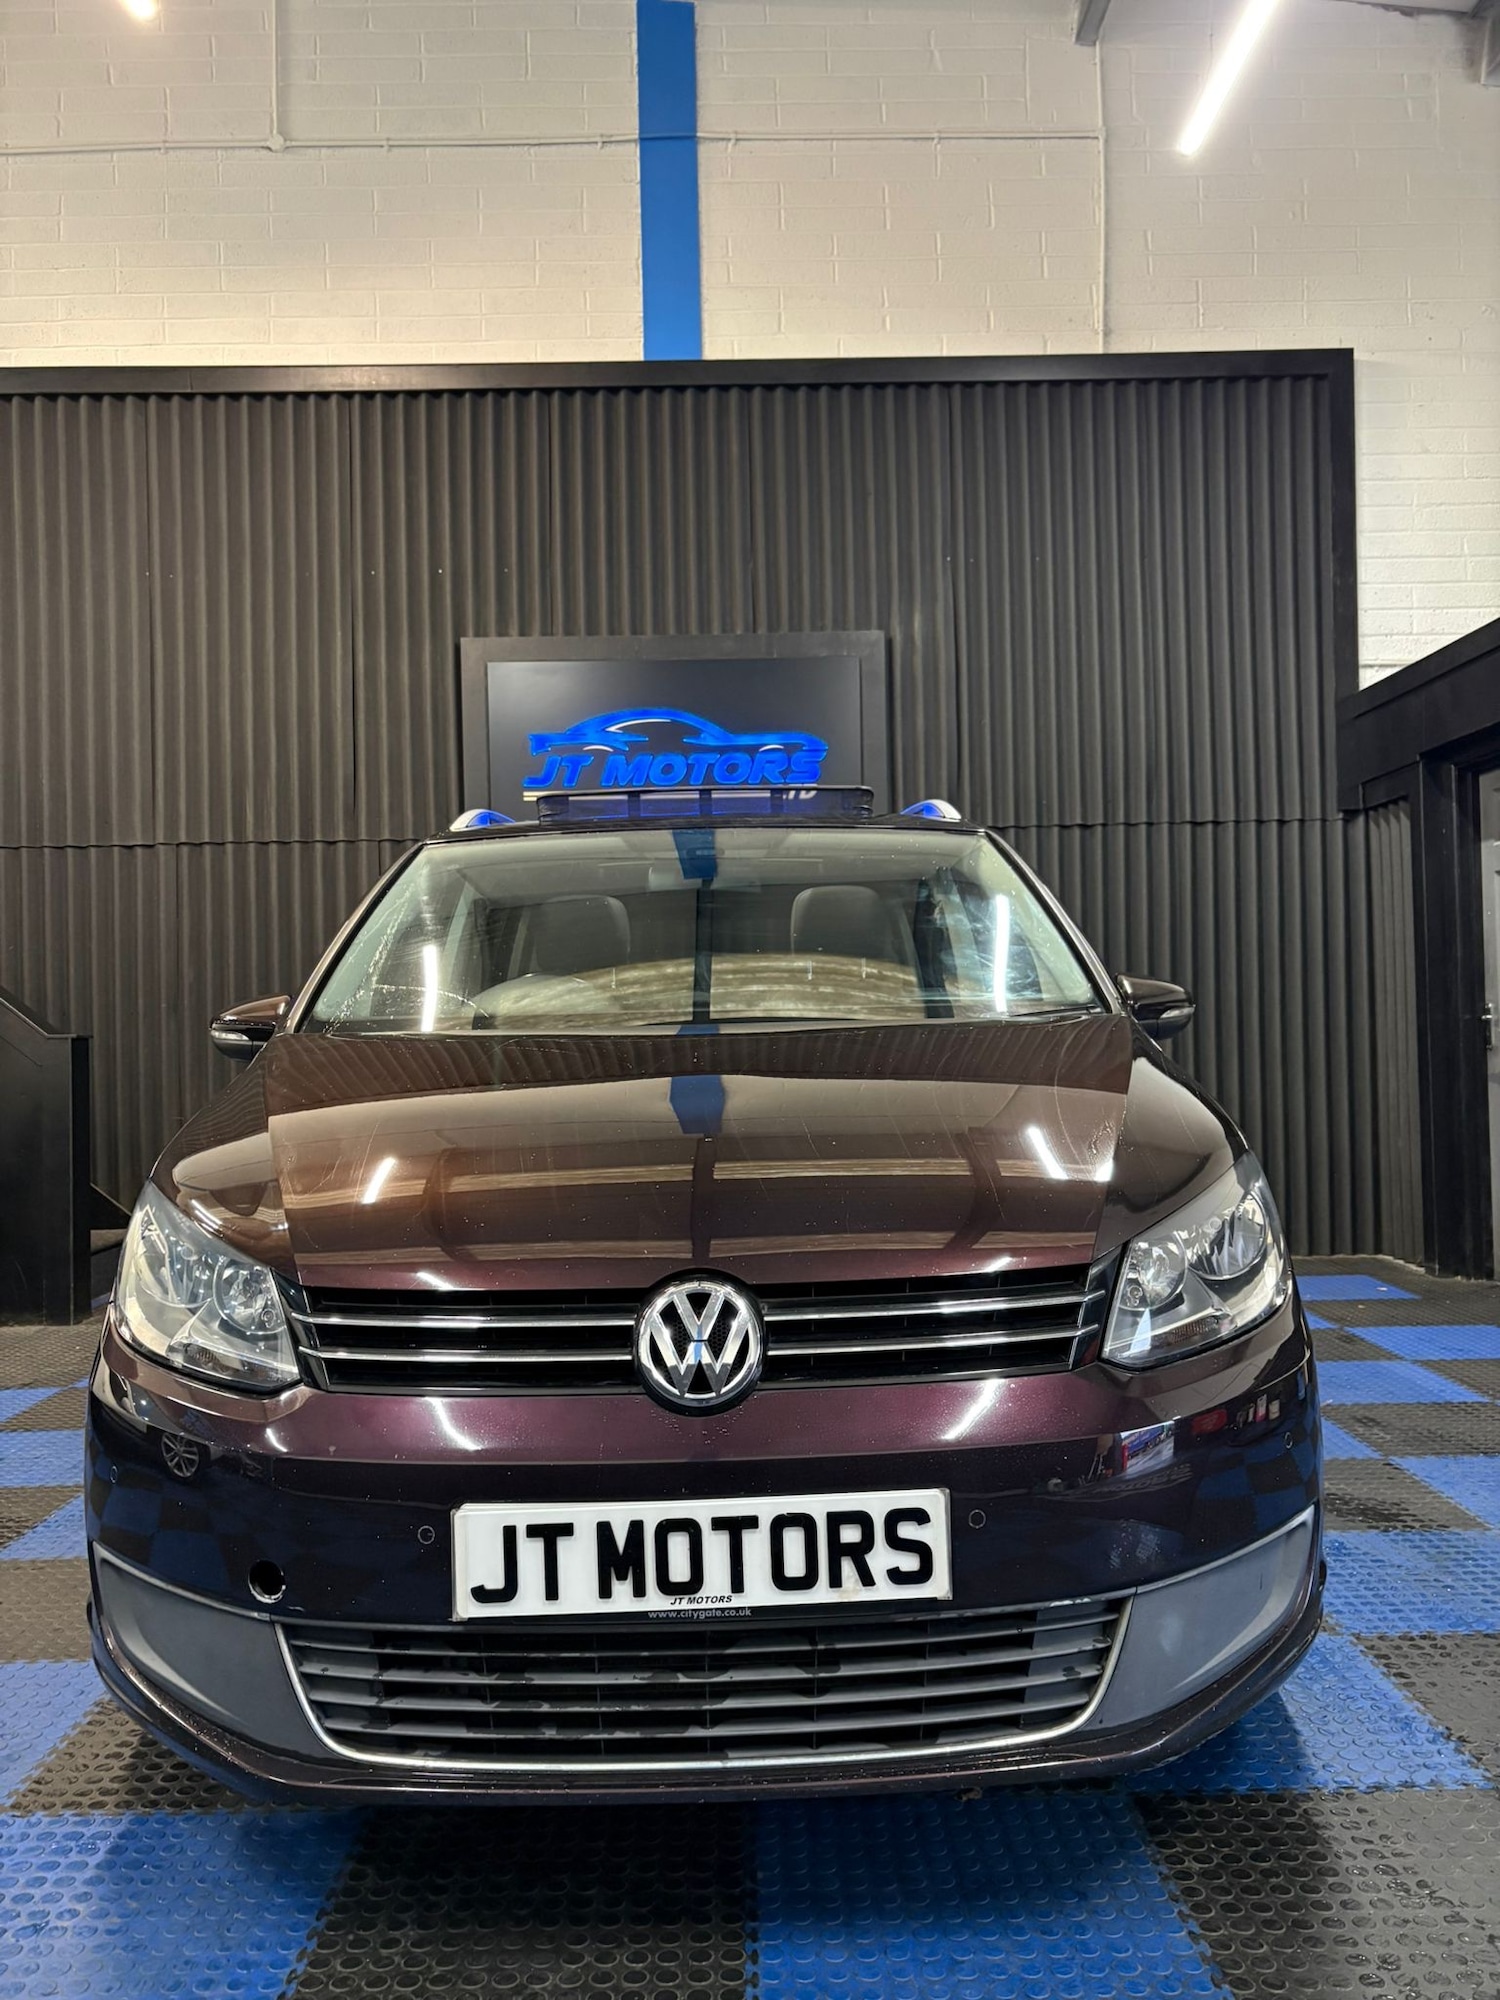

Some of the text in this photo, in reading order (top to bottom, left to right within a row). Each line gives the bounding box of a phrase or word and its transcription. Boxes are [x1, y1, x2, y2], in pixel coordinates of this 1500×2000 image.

[522, 748, 828, 788] JT MOTORS
[470, 1506, 934, 1605] JT MOTORS
[647, 1607, 752, 1620] www.citygate.co.uk
[670, 1595, 733, 1606] JT MOTORS
